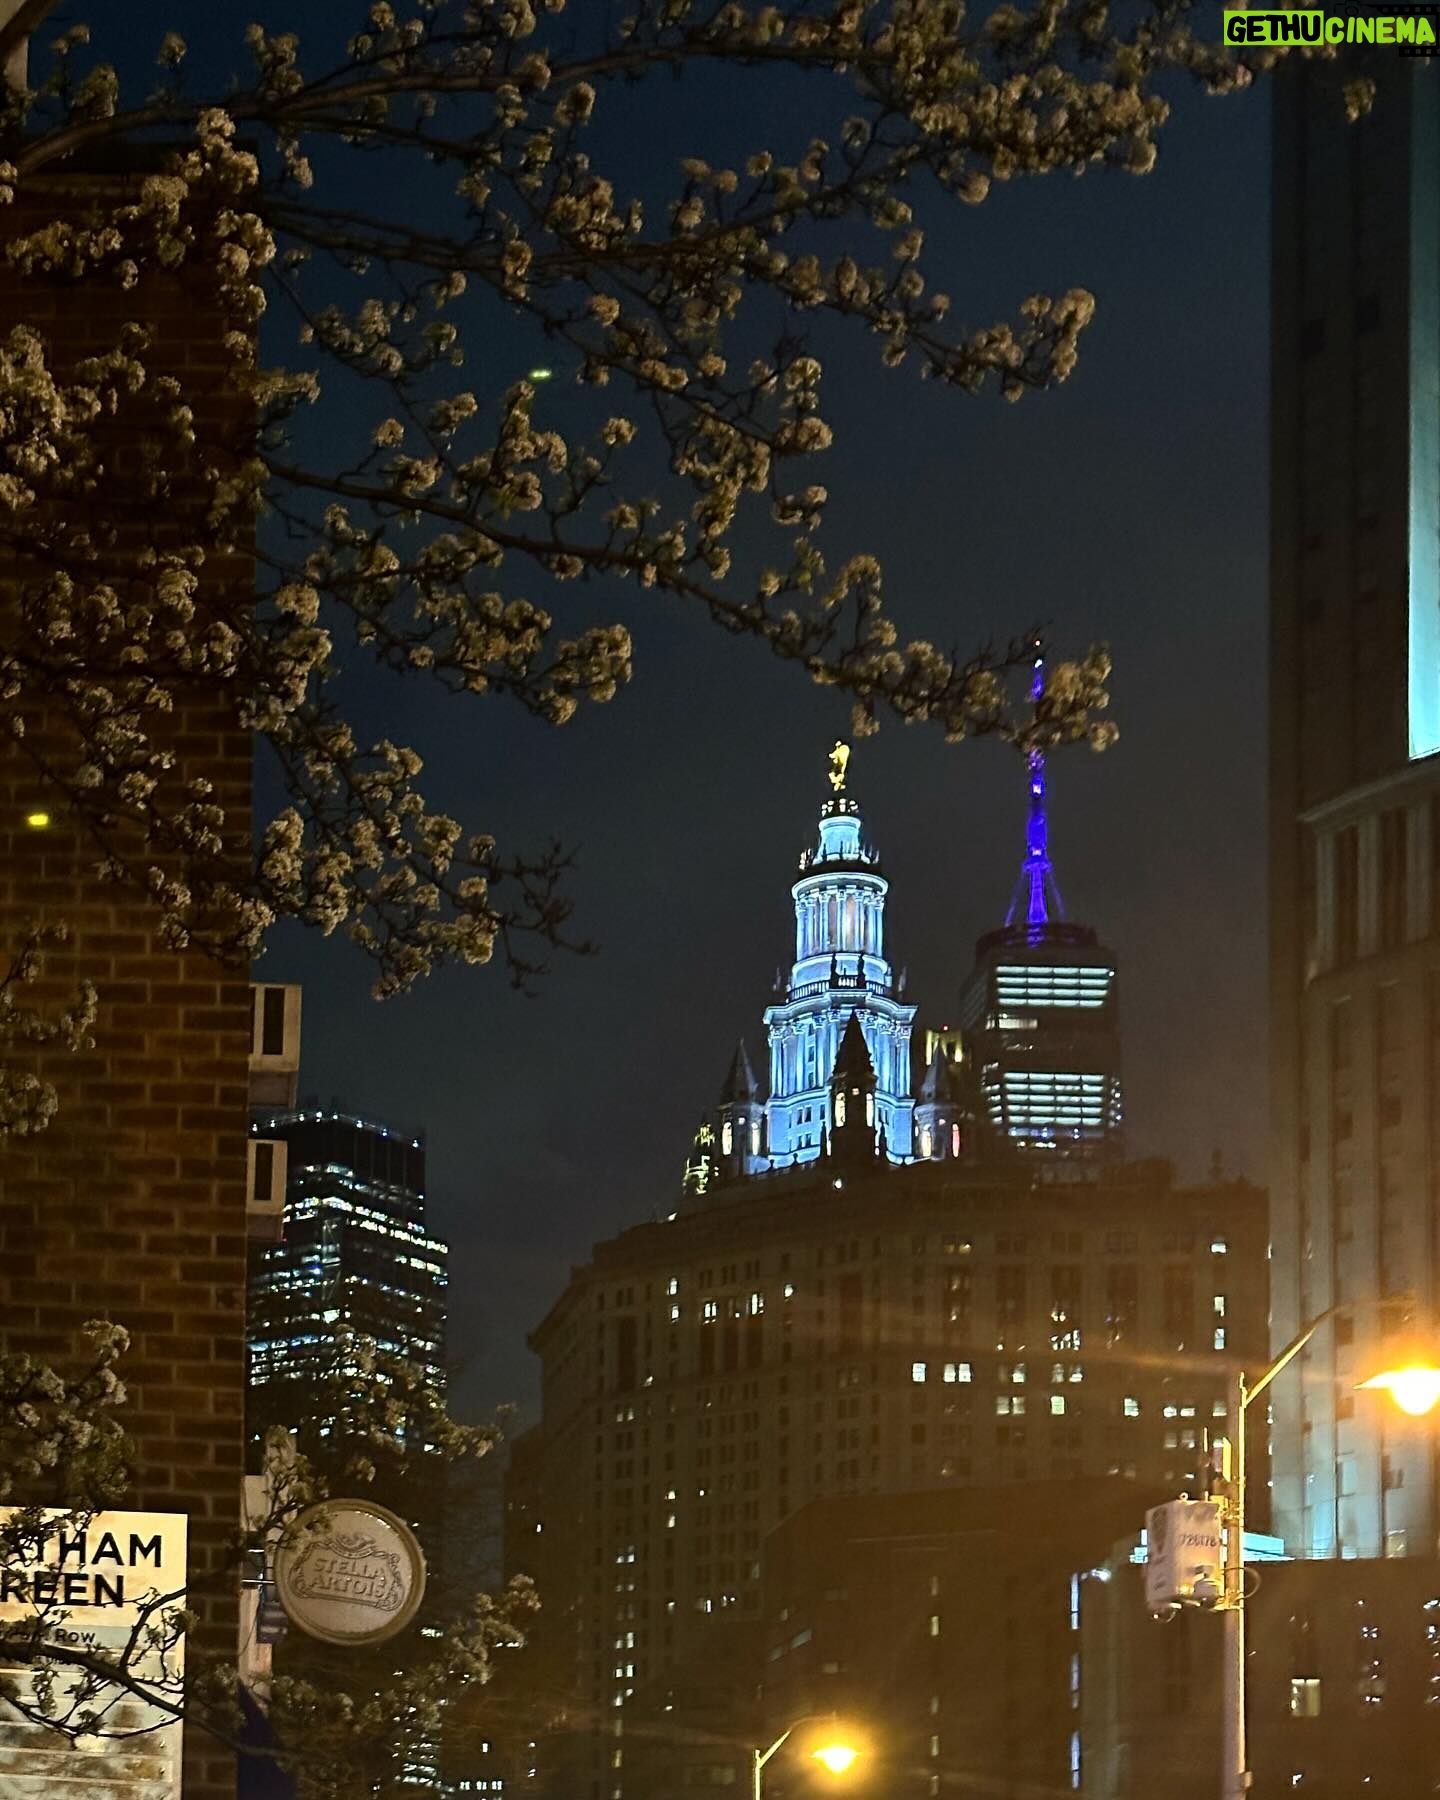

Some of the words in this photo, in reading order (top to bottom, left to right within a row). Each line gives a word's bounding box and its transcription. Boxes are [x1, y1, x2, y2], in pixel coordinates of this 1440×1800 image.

[313, 1557, 387, 1580] STELLA
[0, 1569, 124, 1607] REEN
[310, 1573, 386, 1599] ARTOIS
